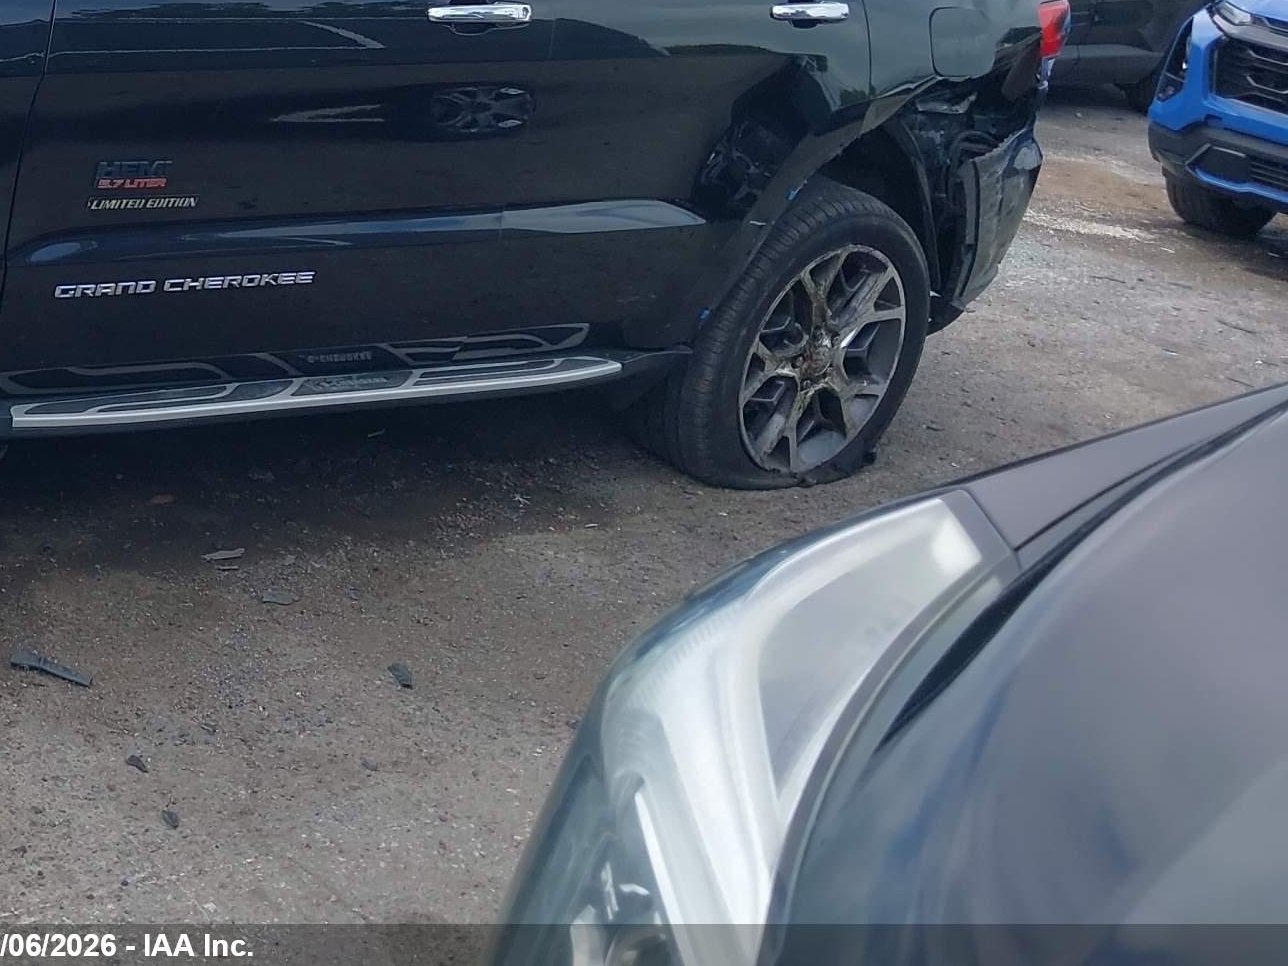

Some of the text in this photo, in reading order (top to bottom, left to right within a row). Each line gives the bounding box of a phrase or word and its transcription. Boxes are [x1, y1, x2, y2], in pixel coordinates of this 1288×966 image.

[90, 196, 198, 211] LIMITED EDITION
[54, 271, 316, 299] GRAND CHEROKEE
